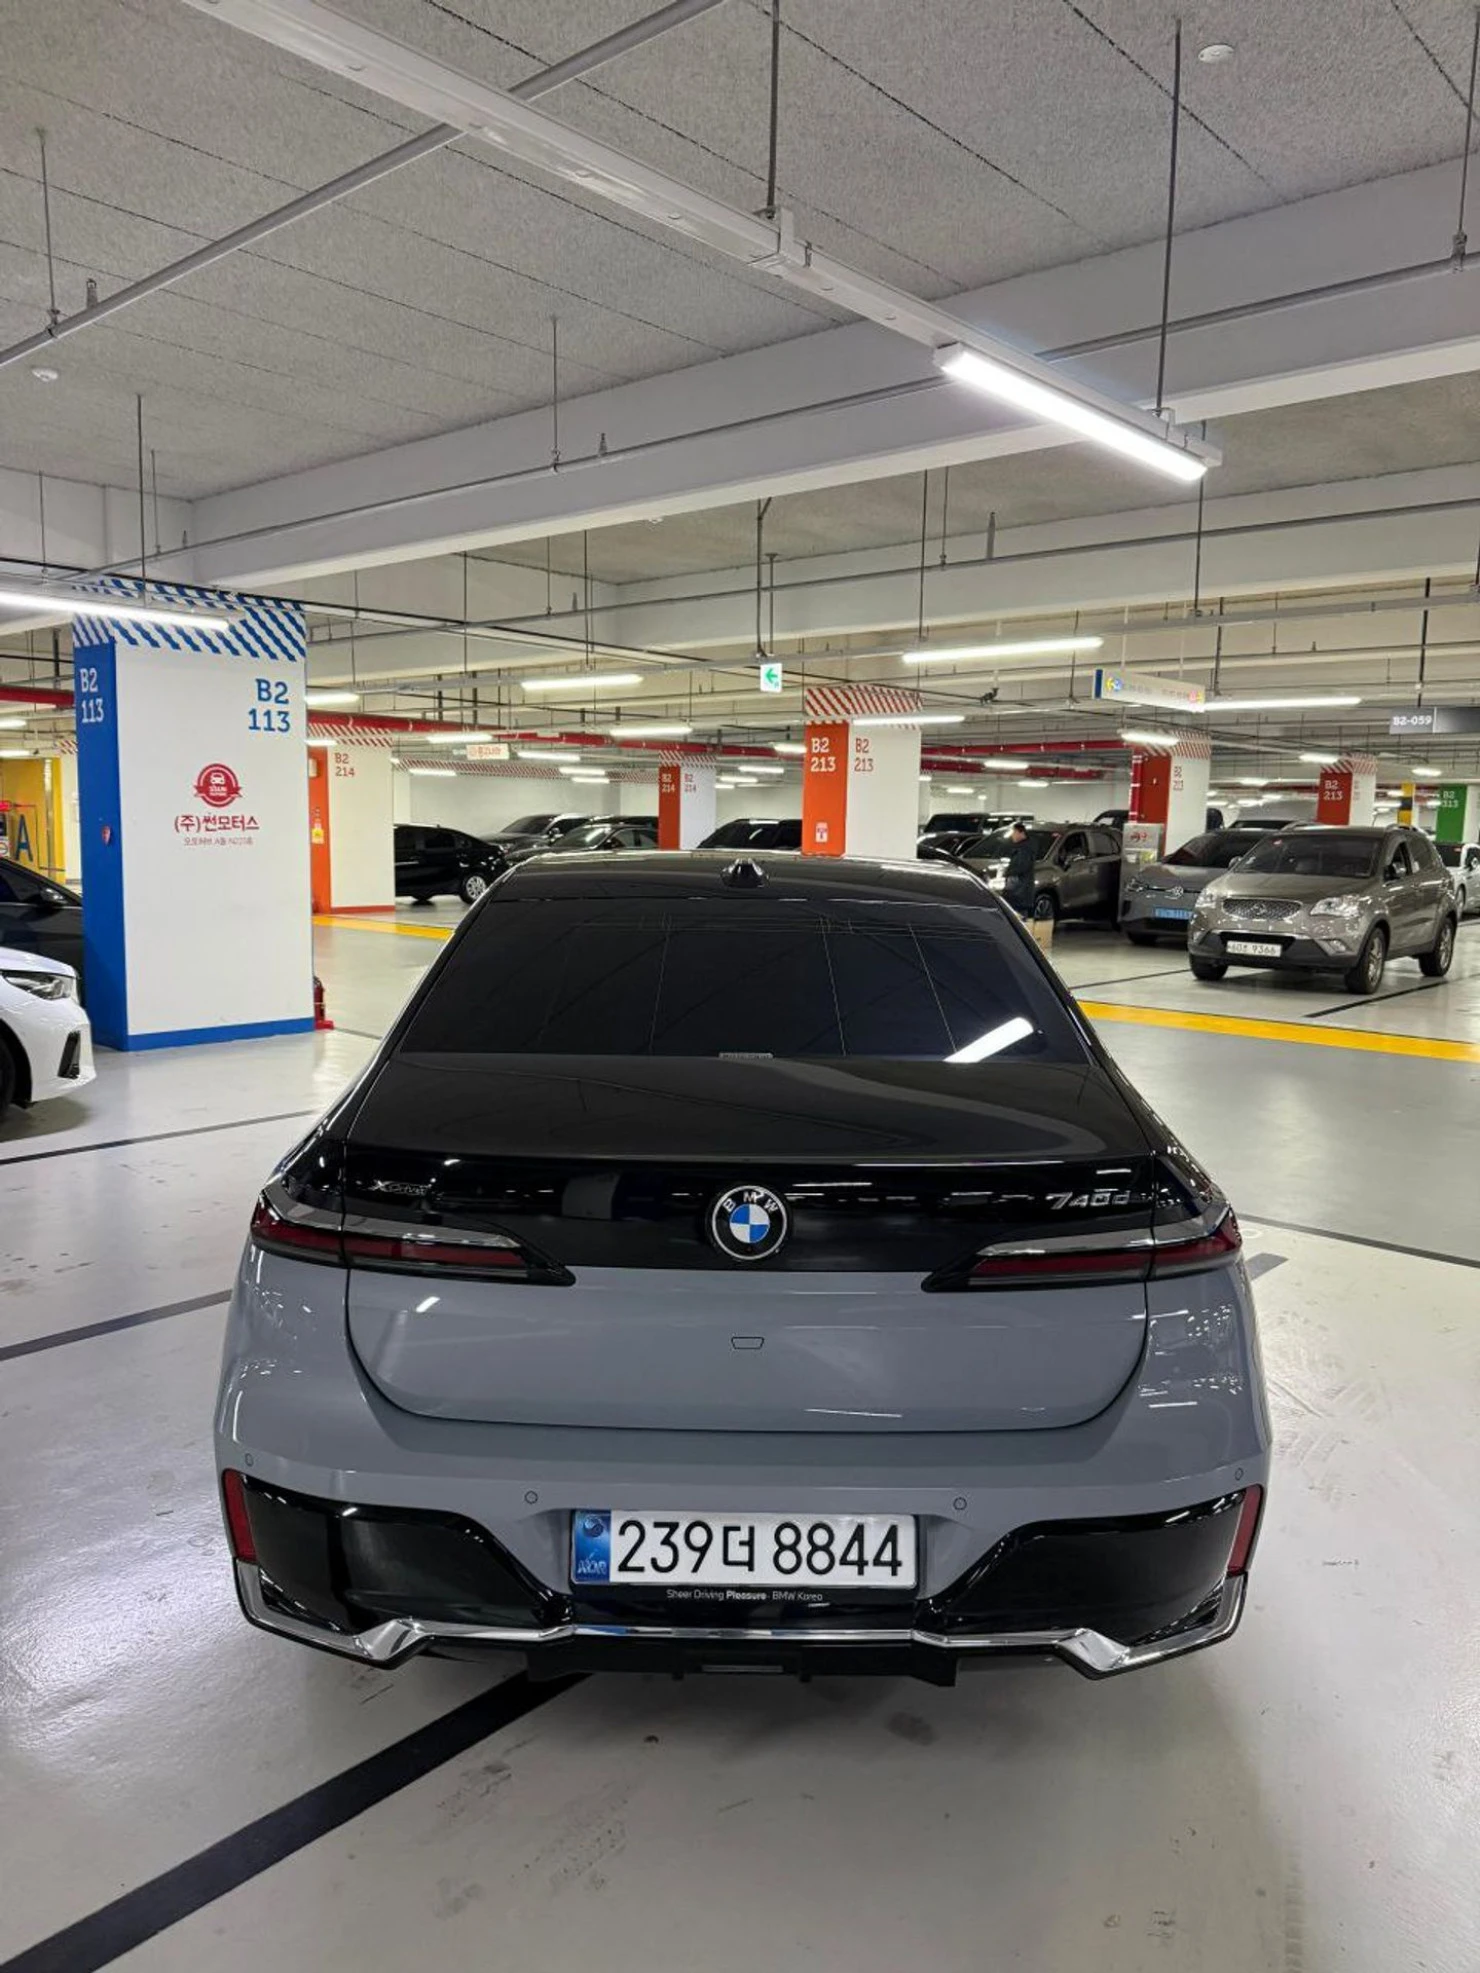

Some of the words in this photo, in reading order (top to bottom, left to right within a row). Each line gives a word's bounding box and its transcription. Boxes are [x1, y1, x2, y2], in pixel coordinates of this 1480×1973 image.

[80, 667, 98, 692] B2
[255, 678, 289, 705] B2
[81, 698, 104, 723] 113
[247, 709, 291, 733] 113
[1392, 715, 1433, 726] B2-059
[811, 737, 830, 753] B2
[855, 738, 870, 753] B2
[335, 752, 349, 764] B2
[810, 757, 836, 772] 213
[854, 759, 874, 772] 213
[335, 766, 355, 777] 214
[1324, 780, 1339, 790] B2
[1323, 791, 1343, 801] 213
[14, 813, 34, 862] A
[723, 1191, 779, 1213] BMW
[618, 1520, 756, 1574] 239더
[773, 1520, 903, 1577] 8844
[666, 1589, 692, 1599] Sheer
[694, 1589, 725, 1601] Driving
[726, 1590, 767, 1600] Pleasure
[772, 1591, 796, 1601] BMW
[797, 1591, 823, 1601] Korea
